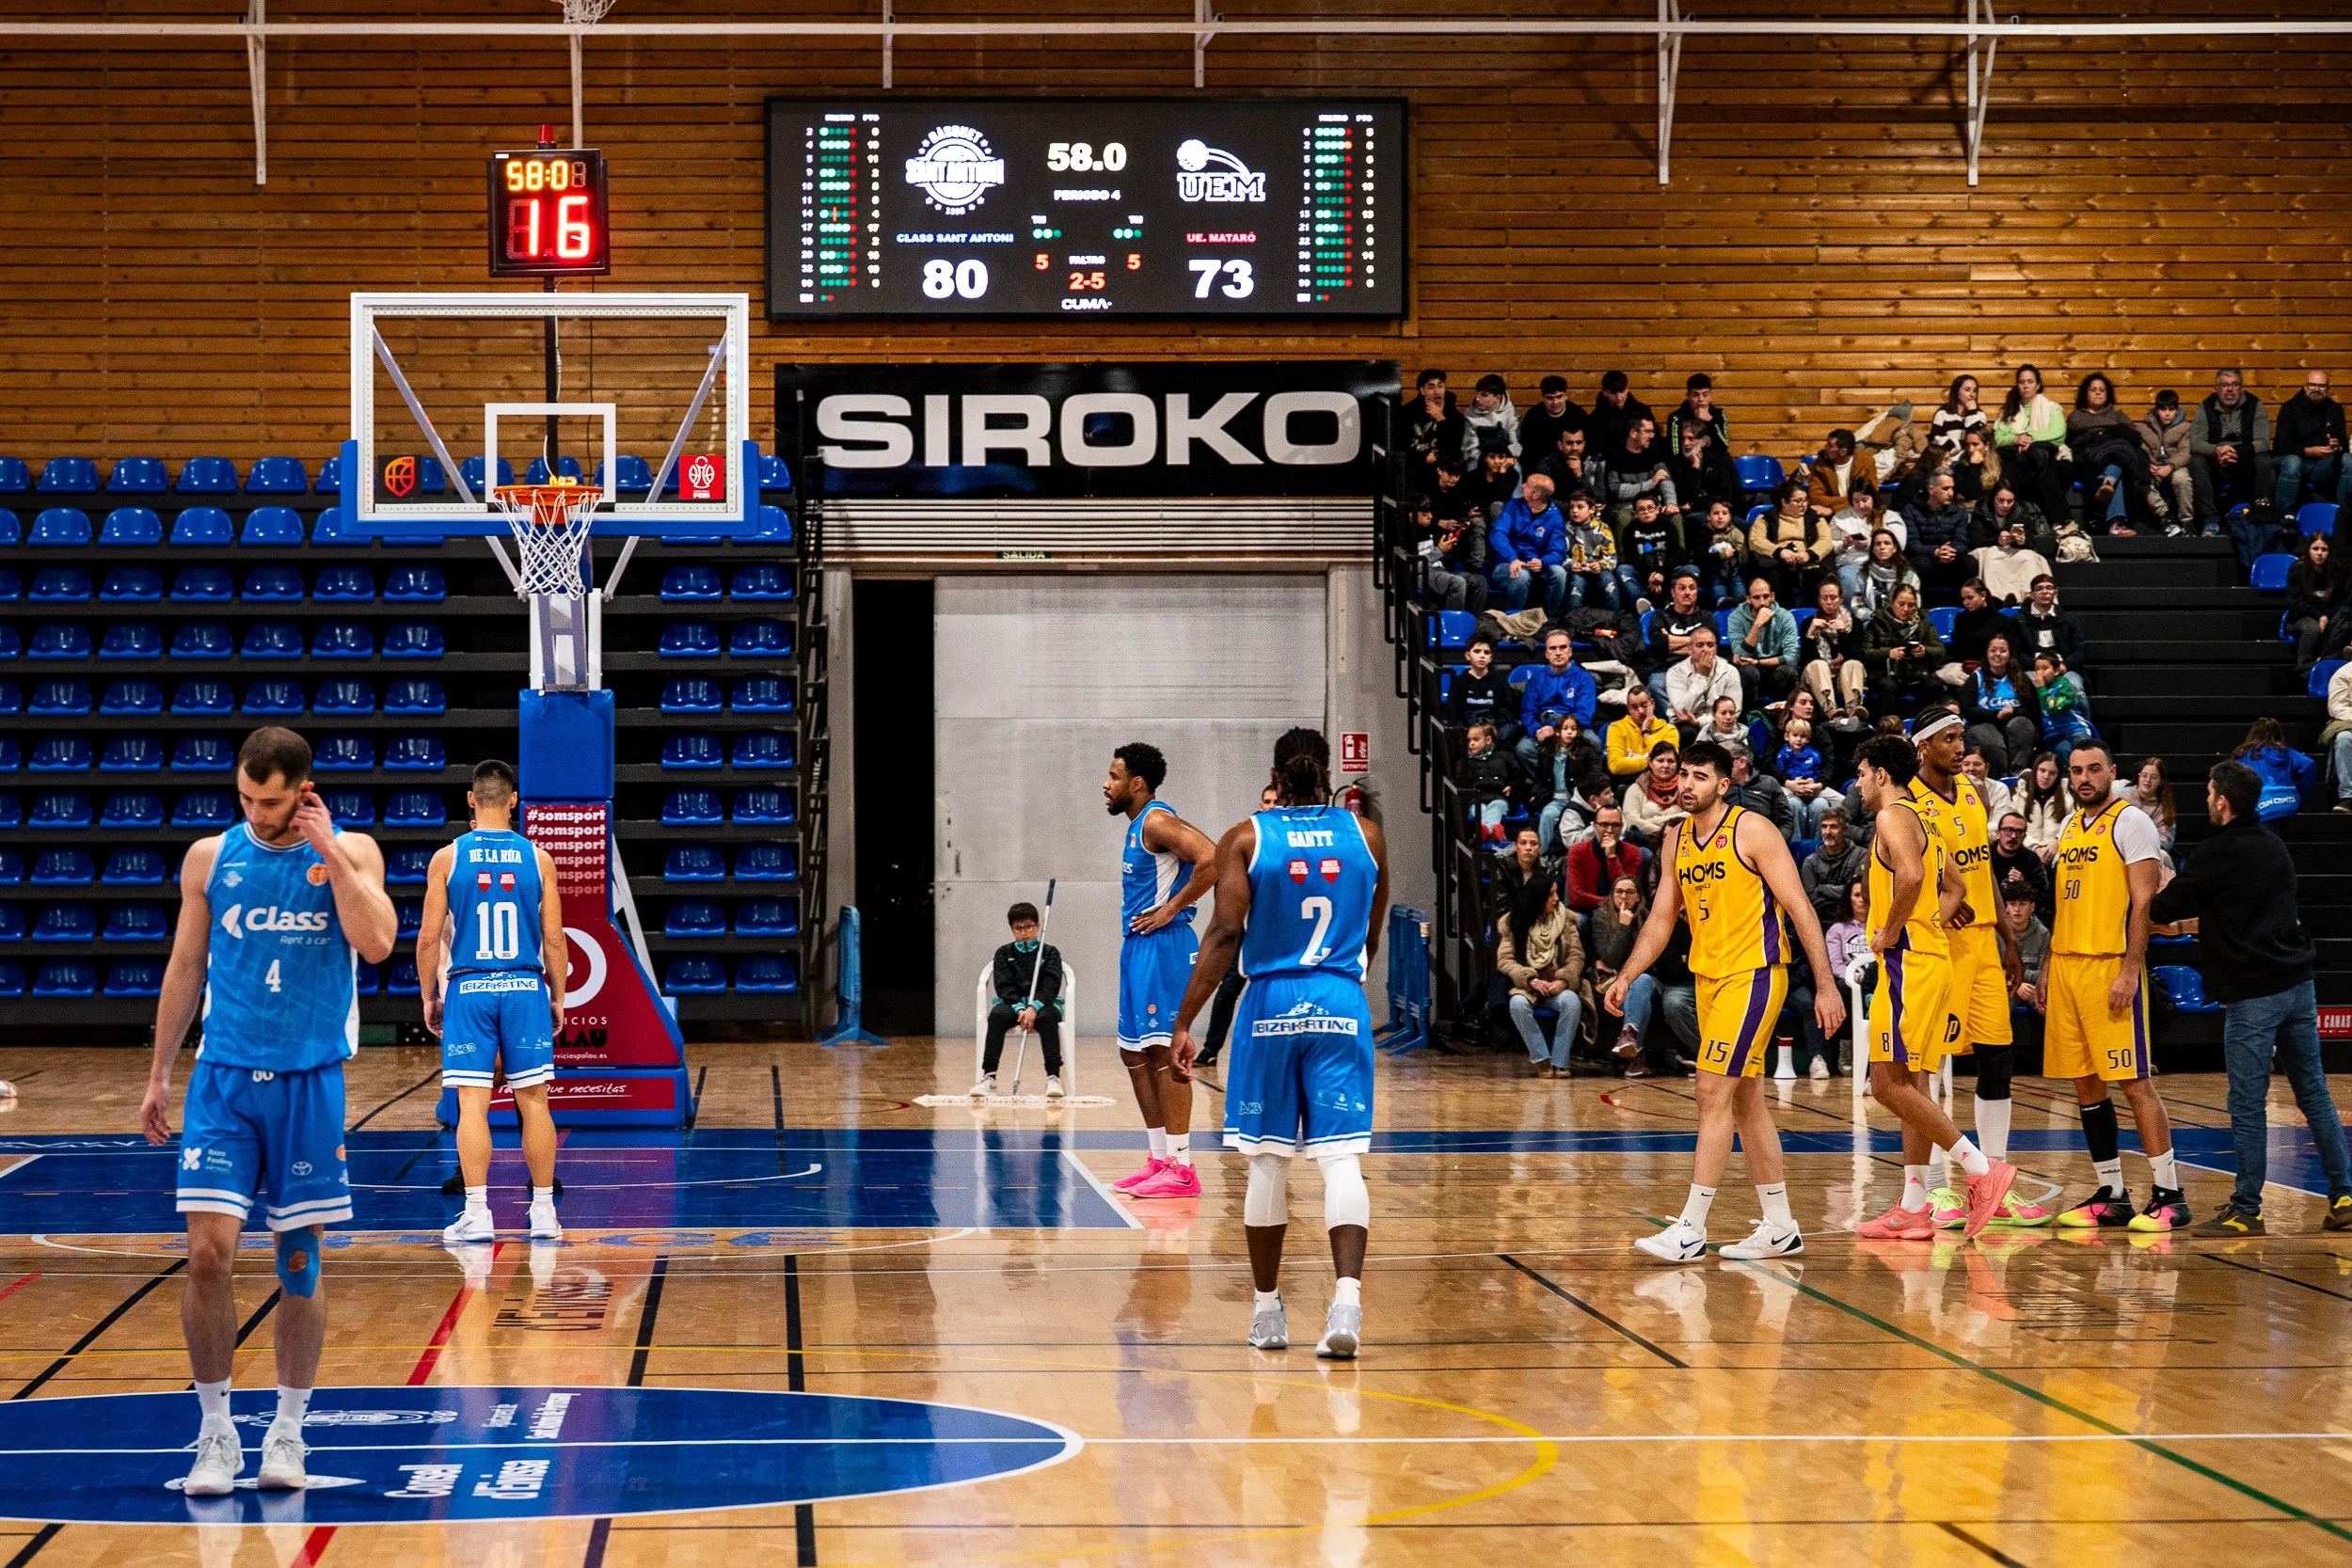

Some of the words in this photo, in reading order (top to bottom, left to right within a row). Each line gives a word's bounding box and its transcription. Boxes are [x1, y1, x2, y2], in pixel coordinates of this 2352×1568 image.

[867, 154, 878, 163] 11
[1046, 142, 1127, 171] 58.0
[1111, 189, 1121, 200] 4
[1176, 171, 1266, 202] UEM
[529, 196, 591, 259] 16
[802, 223, 813, 231] 17
[1298, 223, 1309, 231] 21
[896, 233, 934, 244] CLASS
[936, 233, 968, 244] SANT
[969, 232, 1014, 244] ANTONI
[1298, 237, 1311, 245] 22
[1034, 253, 1050, 271] 5
[1126, 253, 1142, 271] 5
[922, 259, 989, 299] 80
[1068, 271, 1106, 291] 2-5
[1188, 259, 1255, 299] 73
[816, 390, 1361, 468] SIROKO
[527, 809, 606, 823] #somsport
[1953, 816, 1965, 836] 5
[527, 824, 606, 838] #somsport
[1286, 830, 1334, 847] GANTT
[469, 848, 484, 863] DE
[484, 848, 499, 863] LA
[554, 854, 606, 867] msport
[1950, 844, 1990, 866] OMS
[557, 869, 606, 882] msport
[2062, 879, 2081, 900] 50
[245, 905, 329, 932] Class
[1698, 898, 1710, 921] 5
[279, 935, 303, 945] Rent
[475, 901, 519, 959] 10
[1300, 895, 1333, 966] 2
[264, 958, 282, 993] 4
[564, 1016, 608, 1025] ICIOS
[553, 1028, 608, 1049] LAU
[1882, 1031, 1890, 1053] 8
[552, 1052, 608, 1061] rviciospalau.es
[1705, 1038, 1731, 1064] 15
[2106, 1048, 2132, 1069] 50
[568, 1083, 628, 1094] necesitas
[383, 1463, 464, 1498] Consell
[471, 1459, 550, 1500] d'Eivissa
